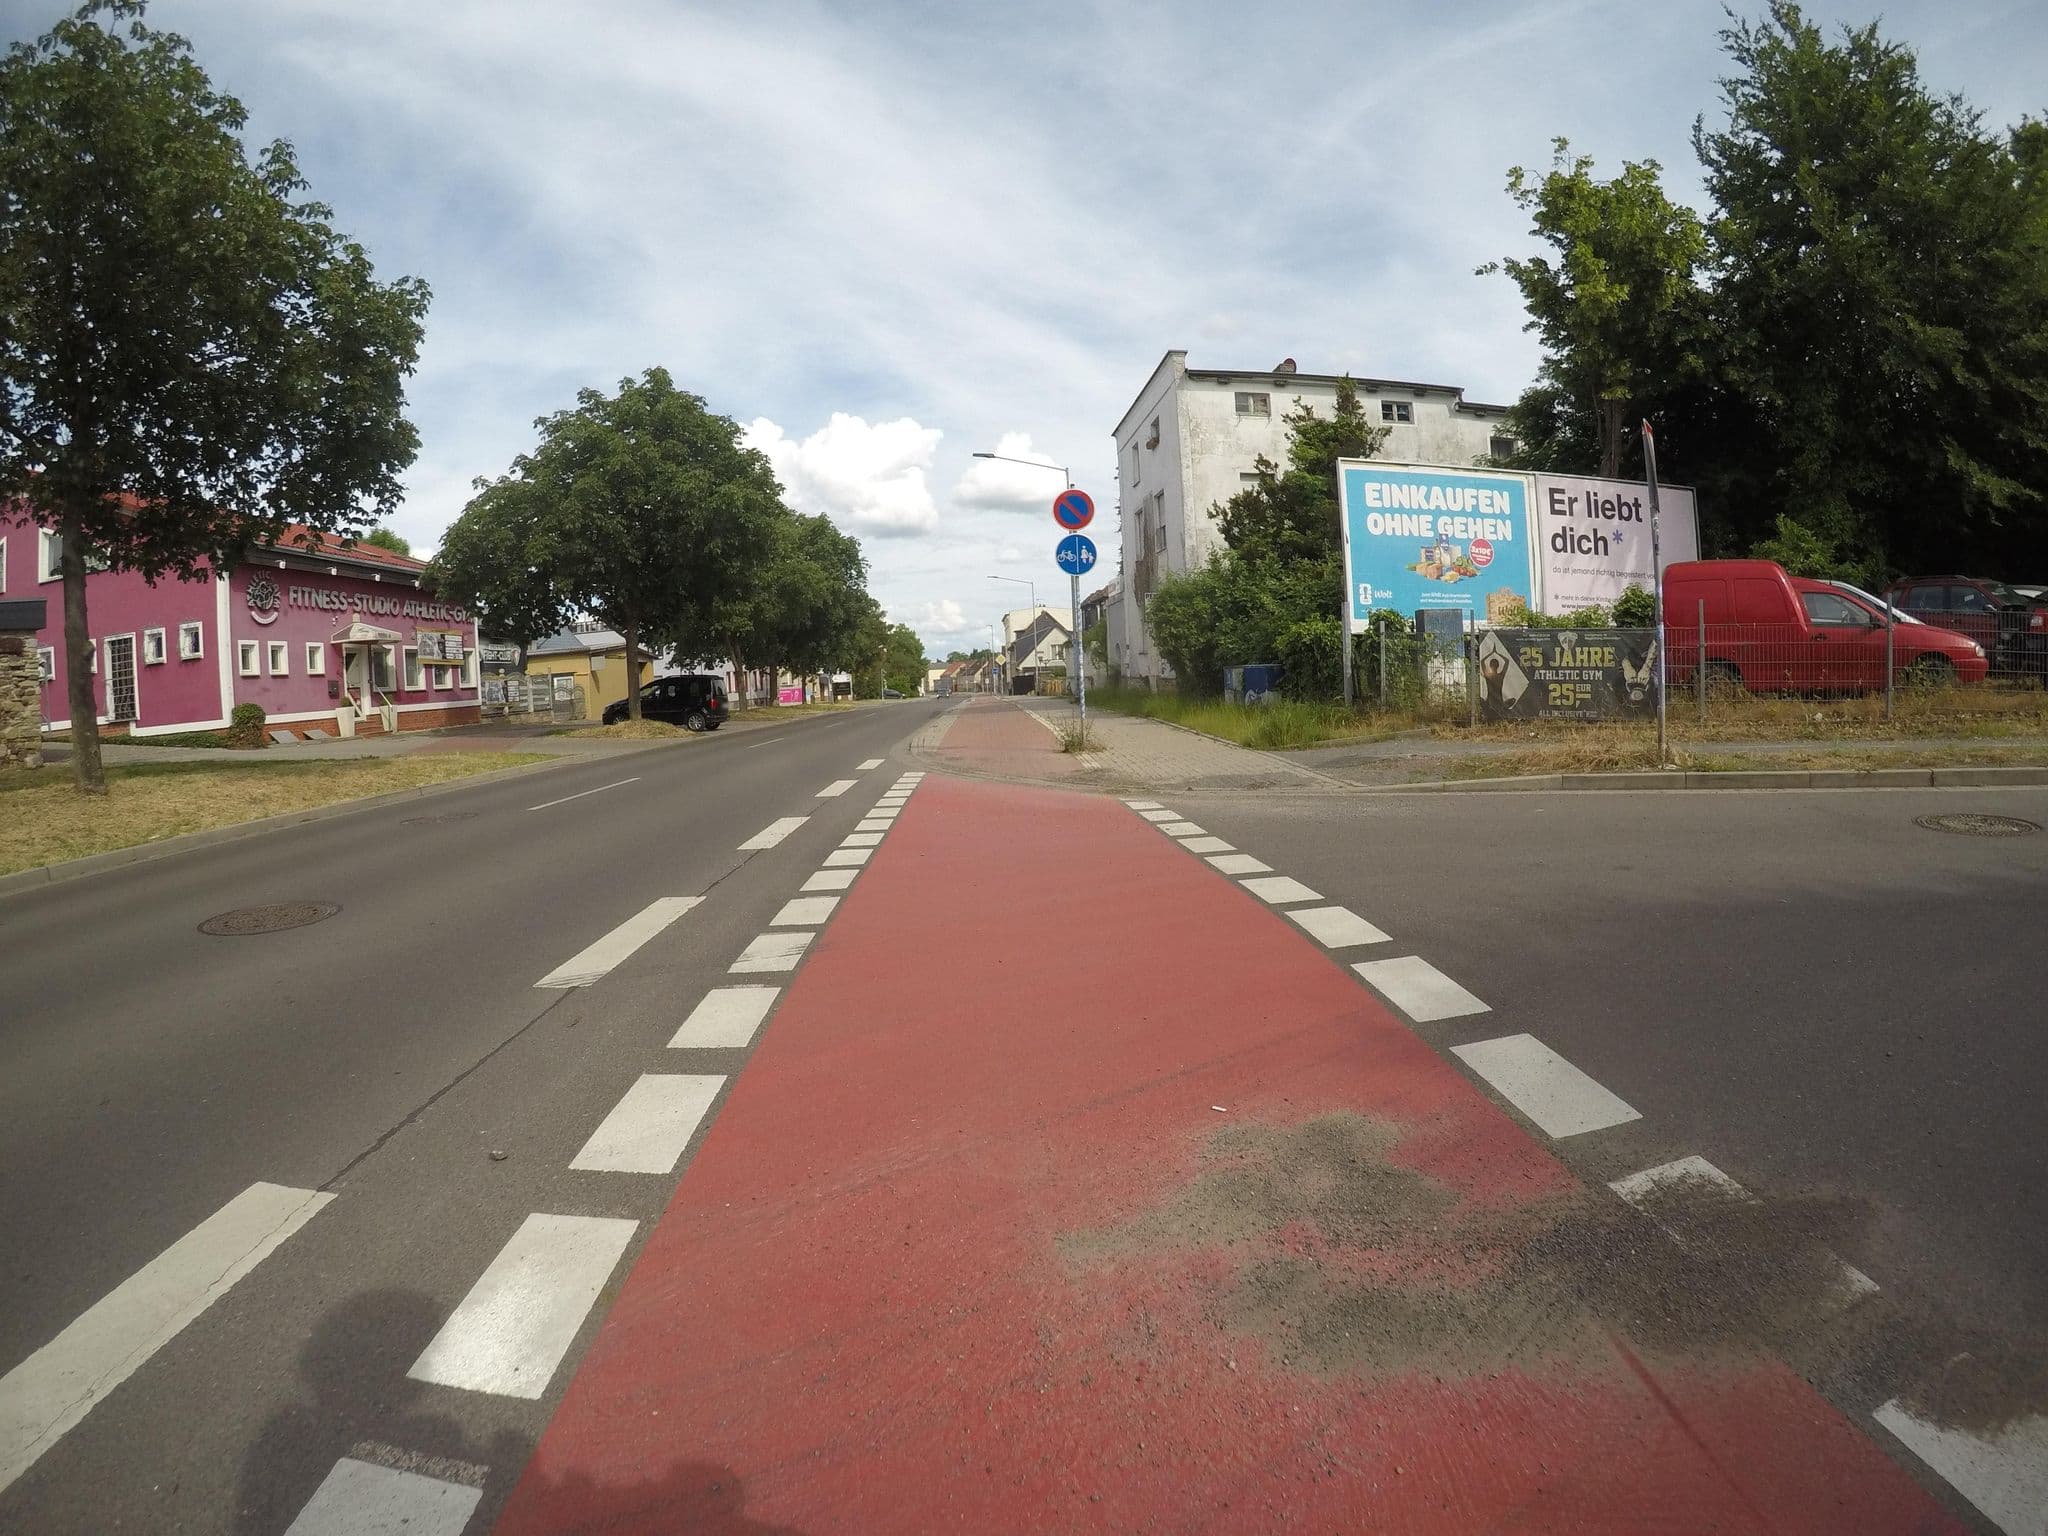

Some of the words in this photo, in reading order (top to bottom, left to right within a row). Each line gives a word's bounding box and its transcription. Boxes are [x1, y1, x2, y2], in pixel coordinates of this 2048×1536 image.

[1364, 482, 1511, 515] EINKAUFEN
[1548, 487, 1578, 517] Er
[1585, 490, 1643, 523] liebt
[1366, 512, 1434, 537] OHNE
[1437, 516, 1512, 541] GEHEN
[1571, 567, 1595, 576] jemand
[1595, 568, 1615, 578] richtig
[1616, 569, 1646, 579] begeistert
[289, 585, 400, 616] FITNESS-STUDIO
[1374, 590, 1393, 599] Wolt
[1519, 646, 1544, 667] 25
[1550, 646, 1616, 668] JAHRE
[1534, 669, 1580, 680] ATHLETIC
[1582, 670, 1603, 681] GYM
[1576, 683, 1591, 692] EUR
[1538, 709, 1551, 717] ALL
